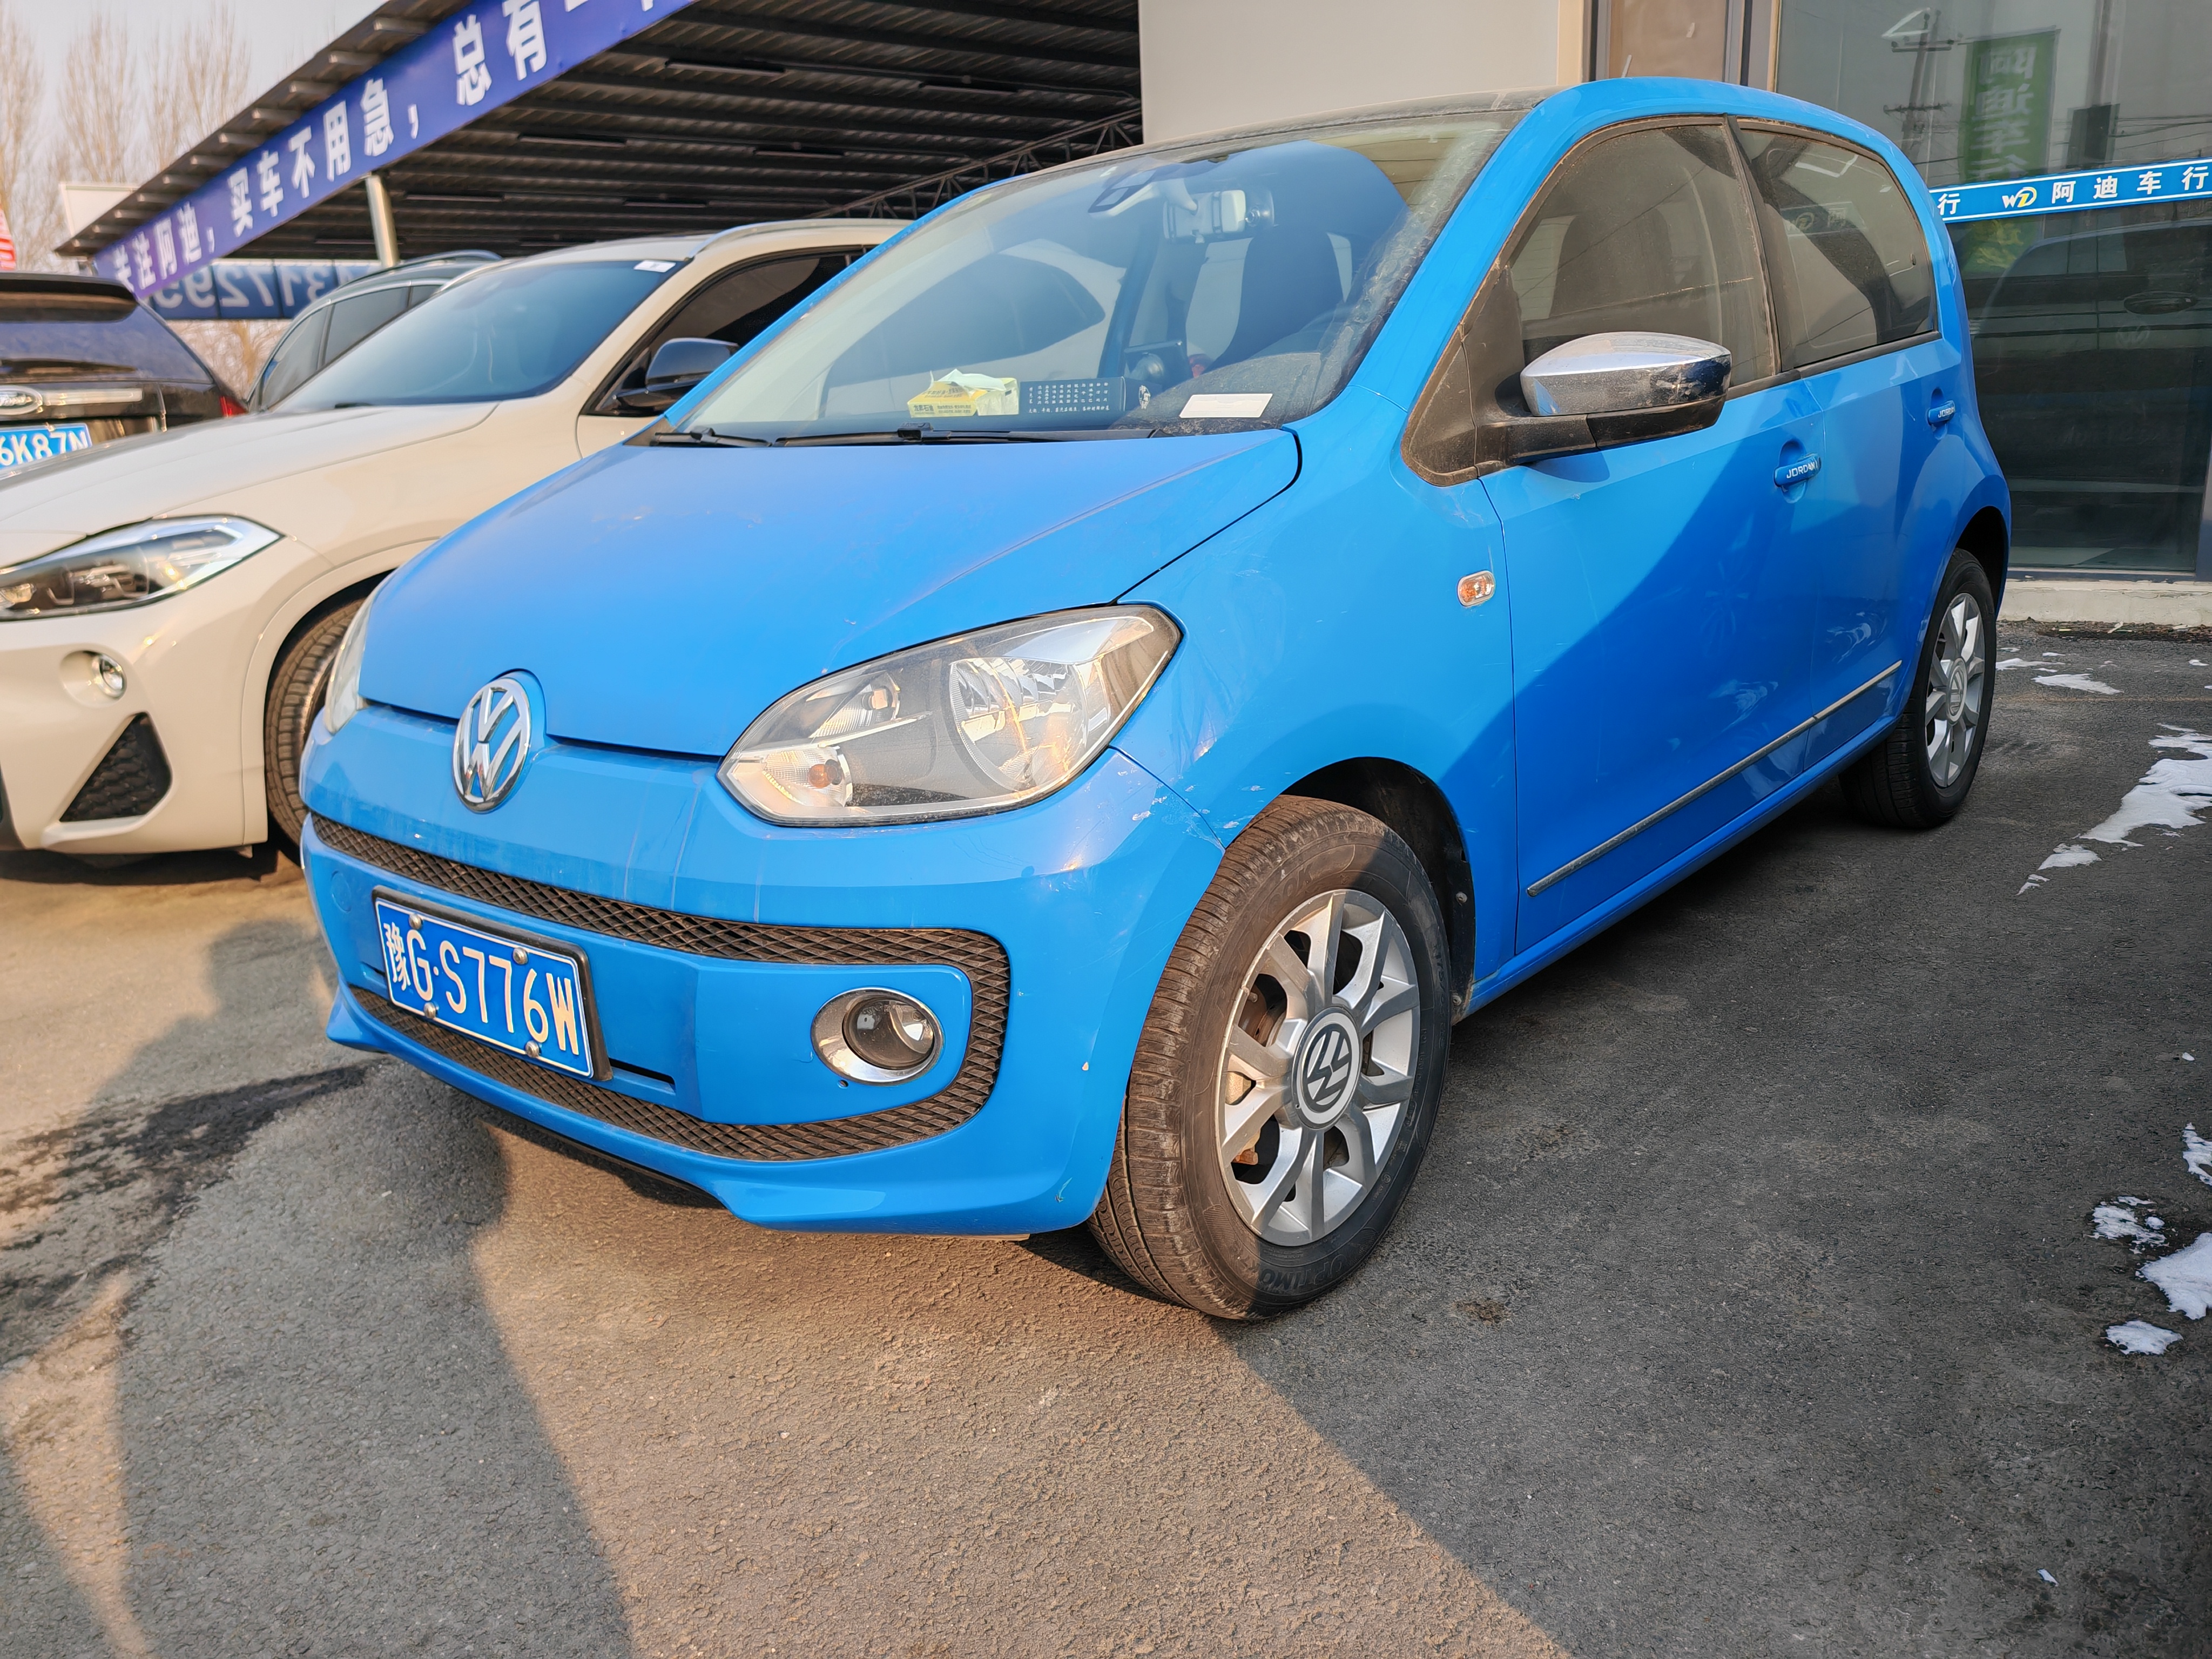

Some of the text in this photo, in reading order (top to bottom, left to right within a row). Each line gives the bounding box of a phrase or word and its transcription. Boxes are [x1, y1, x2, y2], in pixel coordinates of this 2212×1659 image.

[1938, 193, 1961, 215] 行
[2052, 166, 2209, 204] 阿迪车行
[0, 430, 89, 466] 6K87N
[1786, 461, 1816, 479] JORDAN
